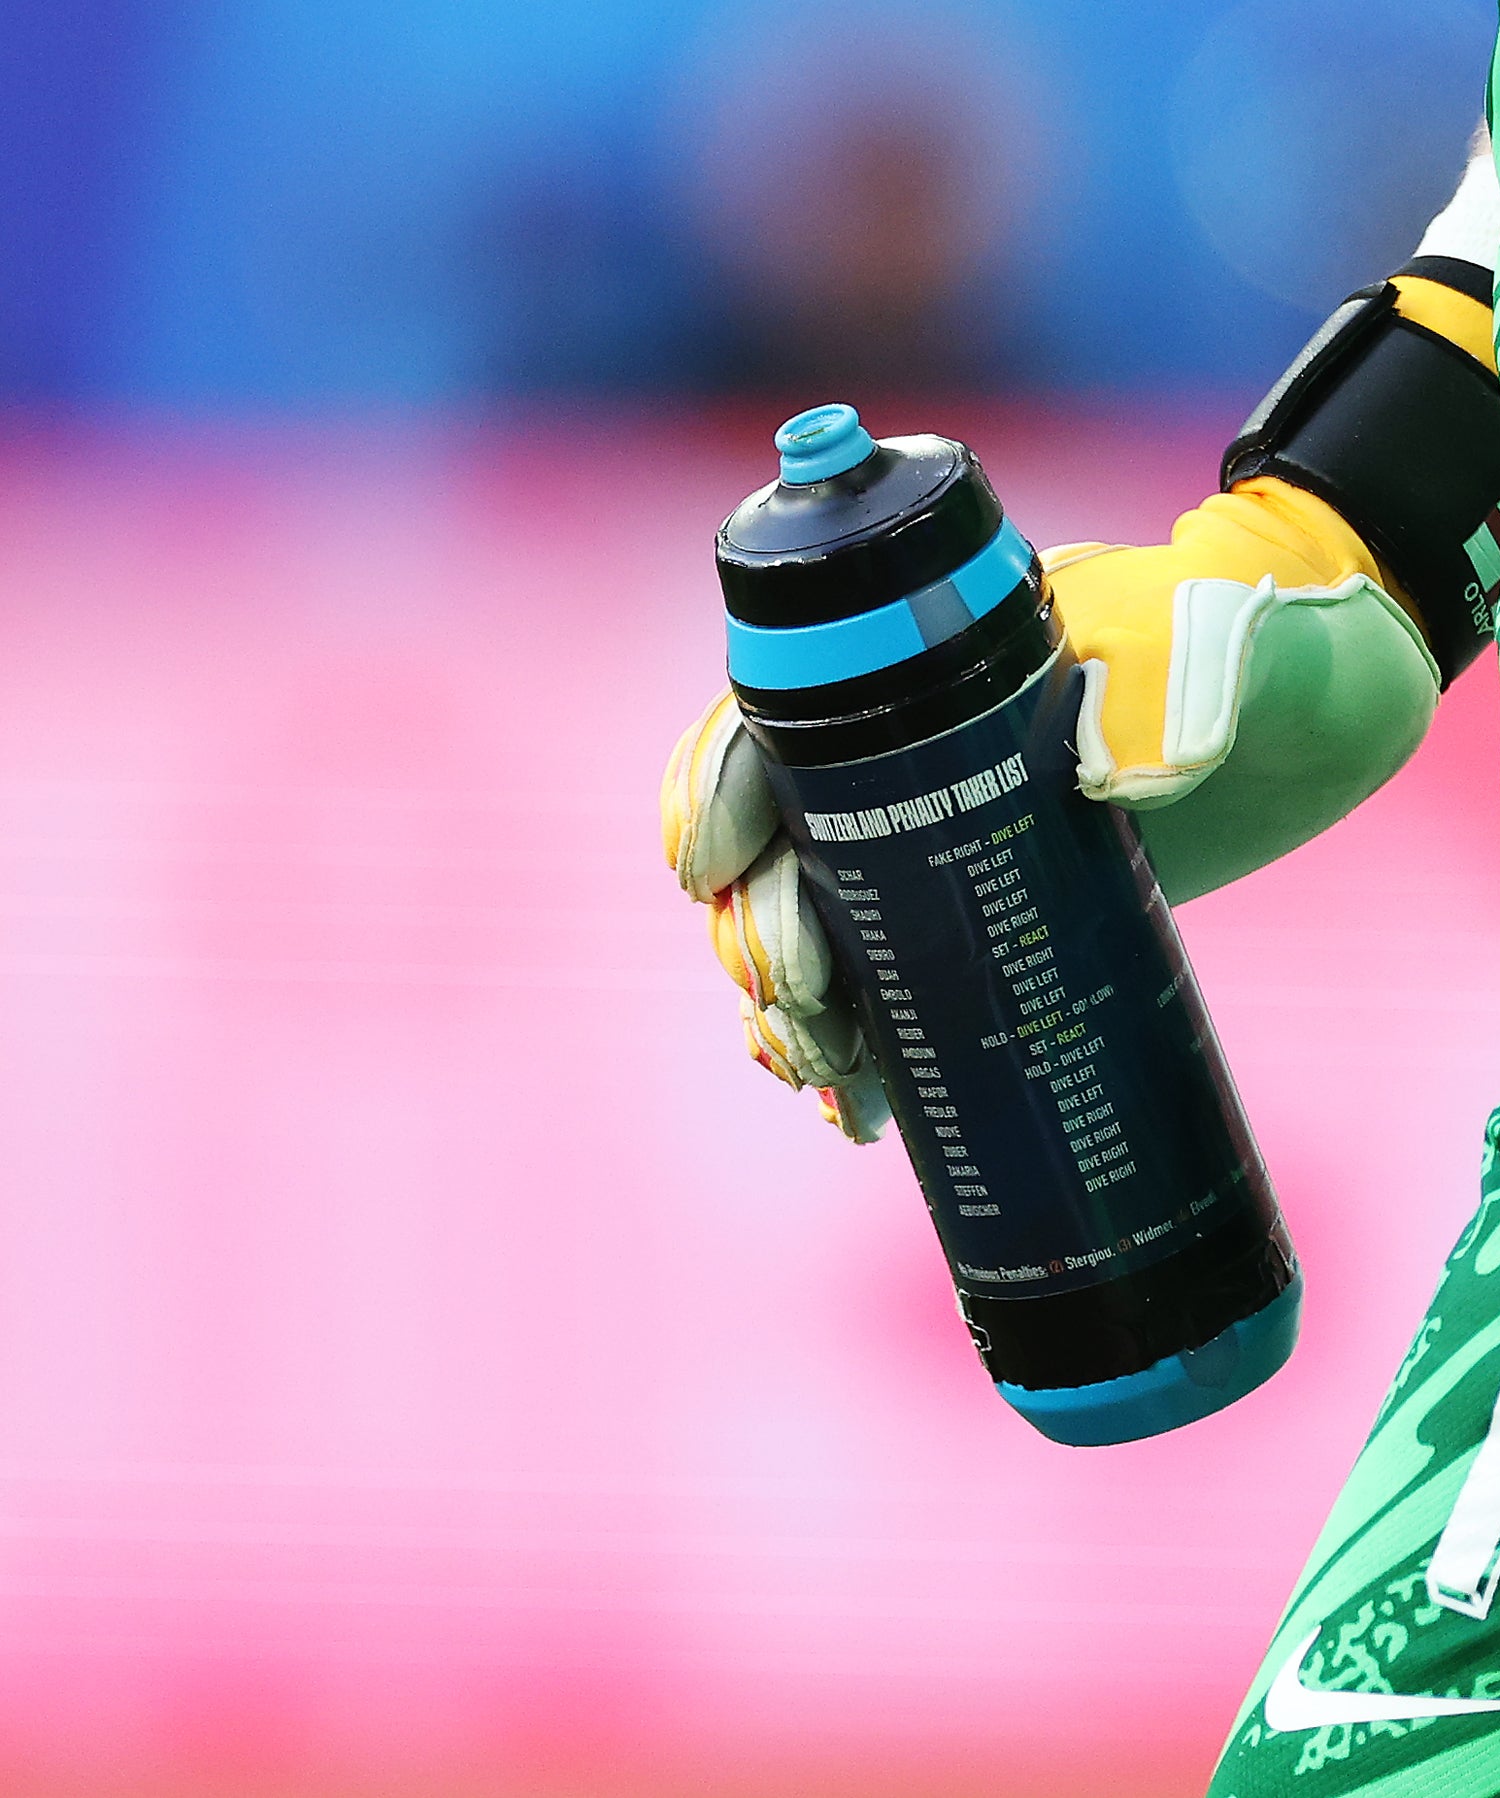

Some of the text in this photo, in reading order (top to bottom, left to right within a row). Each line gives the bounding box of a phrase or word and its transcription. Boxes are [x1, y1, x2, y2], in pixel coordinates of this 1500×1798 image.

[1463, 581, 1495, 636] ARLO
[804, 751, 1029, 841] SWITZERLAND PENALTY TAKER LIST
[928, 850, 954, 867] FAKE
[953, 839, 982, 860] RIGHT
[991, 825, 1014, 845] DIVE
[1013, 813, 1035, 834] LEFT
[967, 848, 1014, 877] DIVE LEFT
[974, 868, 1021, 897] DIVE LEFT
[982, 888, 1028, 917] DIVE LEFT
[987, 906, 1039, 938] DIVE RIGHT
[992, 942, 1010, 959] SET
[1019, 925, 1050, 948] REACT
[1001, 946, 1054, 978] DIVE RIGHT
[880, 989, 913, 1000] EMBOLO
[1012, 967, 1059, 996] DIVE LEFT
[1020, 986, 1066, 1015] DIVE LEFT
[980, 1032, 1008, 1050] HOLD
[1016, 1020, 1040, 1038] DIVE
[1040, 1010, 1064, 1030] LEFT
[1090, 984, 1115, 1006] (LOW)
[1028, 1039, 1048, 1056] SET
[1056, 1022, 1087, 1045] REACT
[910, 1067, 941, 1078] VARGAS
[1024, 1061, 1052, 1080] HOLD
[1060, 1047, 1084, 1067] DIVE
[1083, 1036, 1106, 1055] LEFT
[1050, 1064, 1097, 1093] DIVE LEFT
[1057, 1083, 1104, 1113] DIVE LEFT
[1062, 1102, 1114, 1134] DIVE RIGHT
[1069, 1121, 1122, 1153] DIVE RIGHT
[946, 1165, 980, 1177] ZAKARIA
[1077, 1141, 1130, 1173] DIVE RIGHT
[953, 1185, 988, 1197] STEFFEN
[1085, 1160, 1137, 1193] DIVE RIGHT
